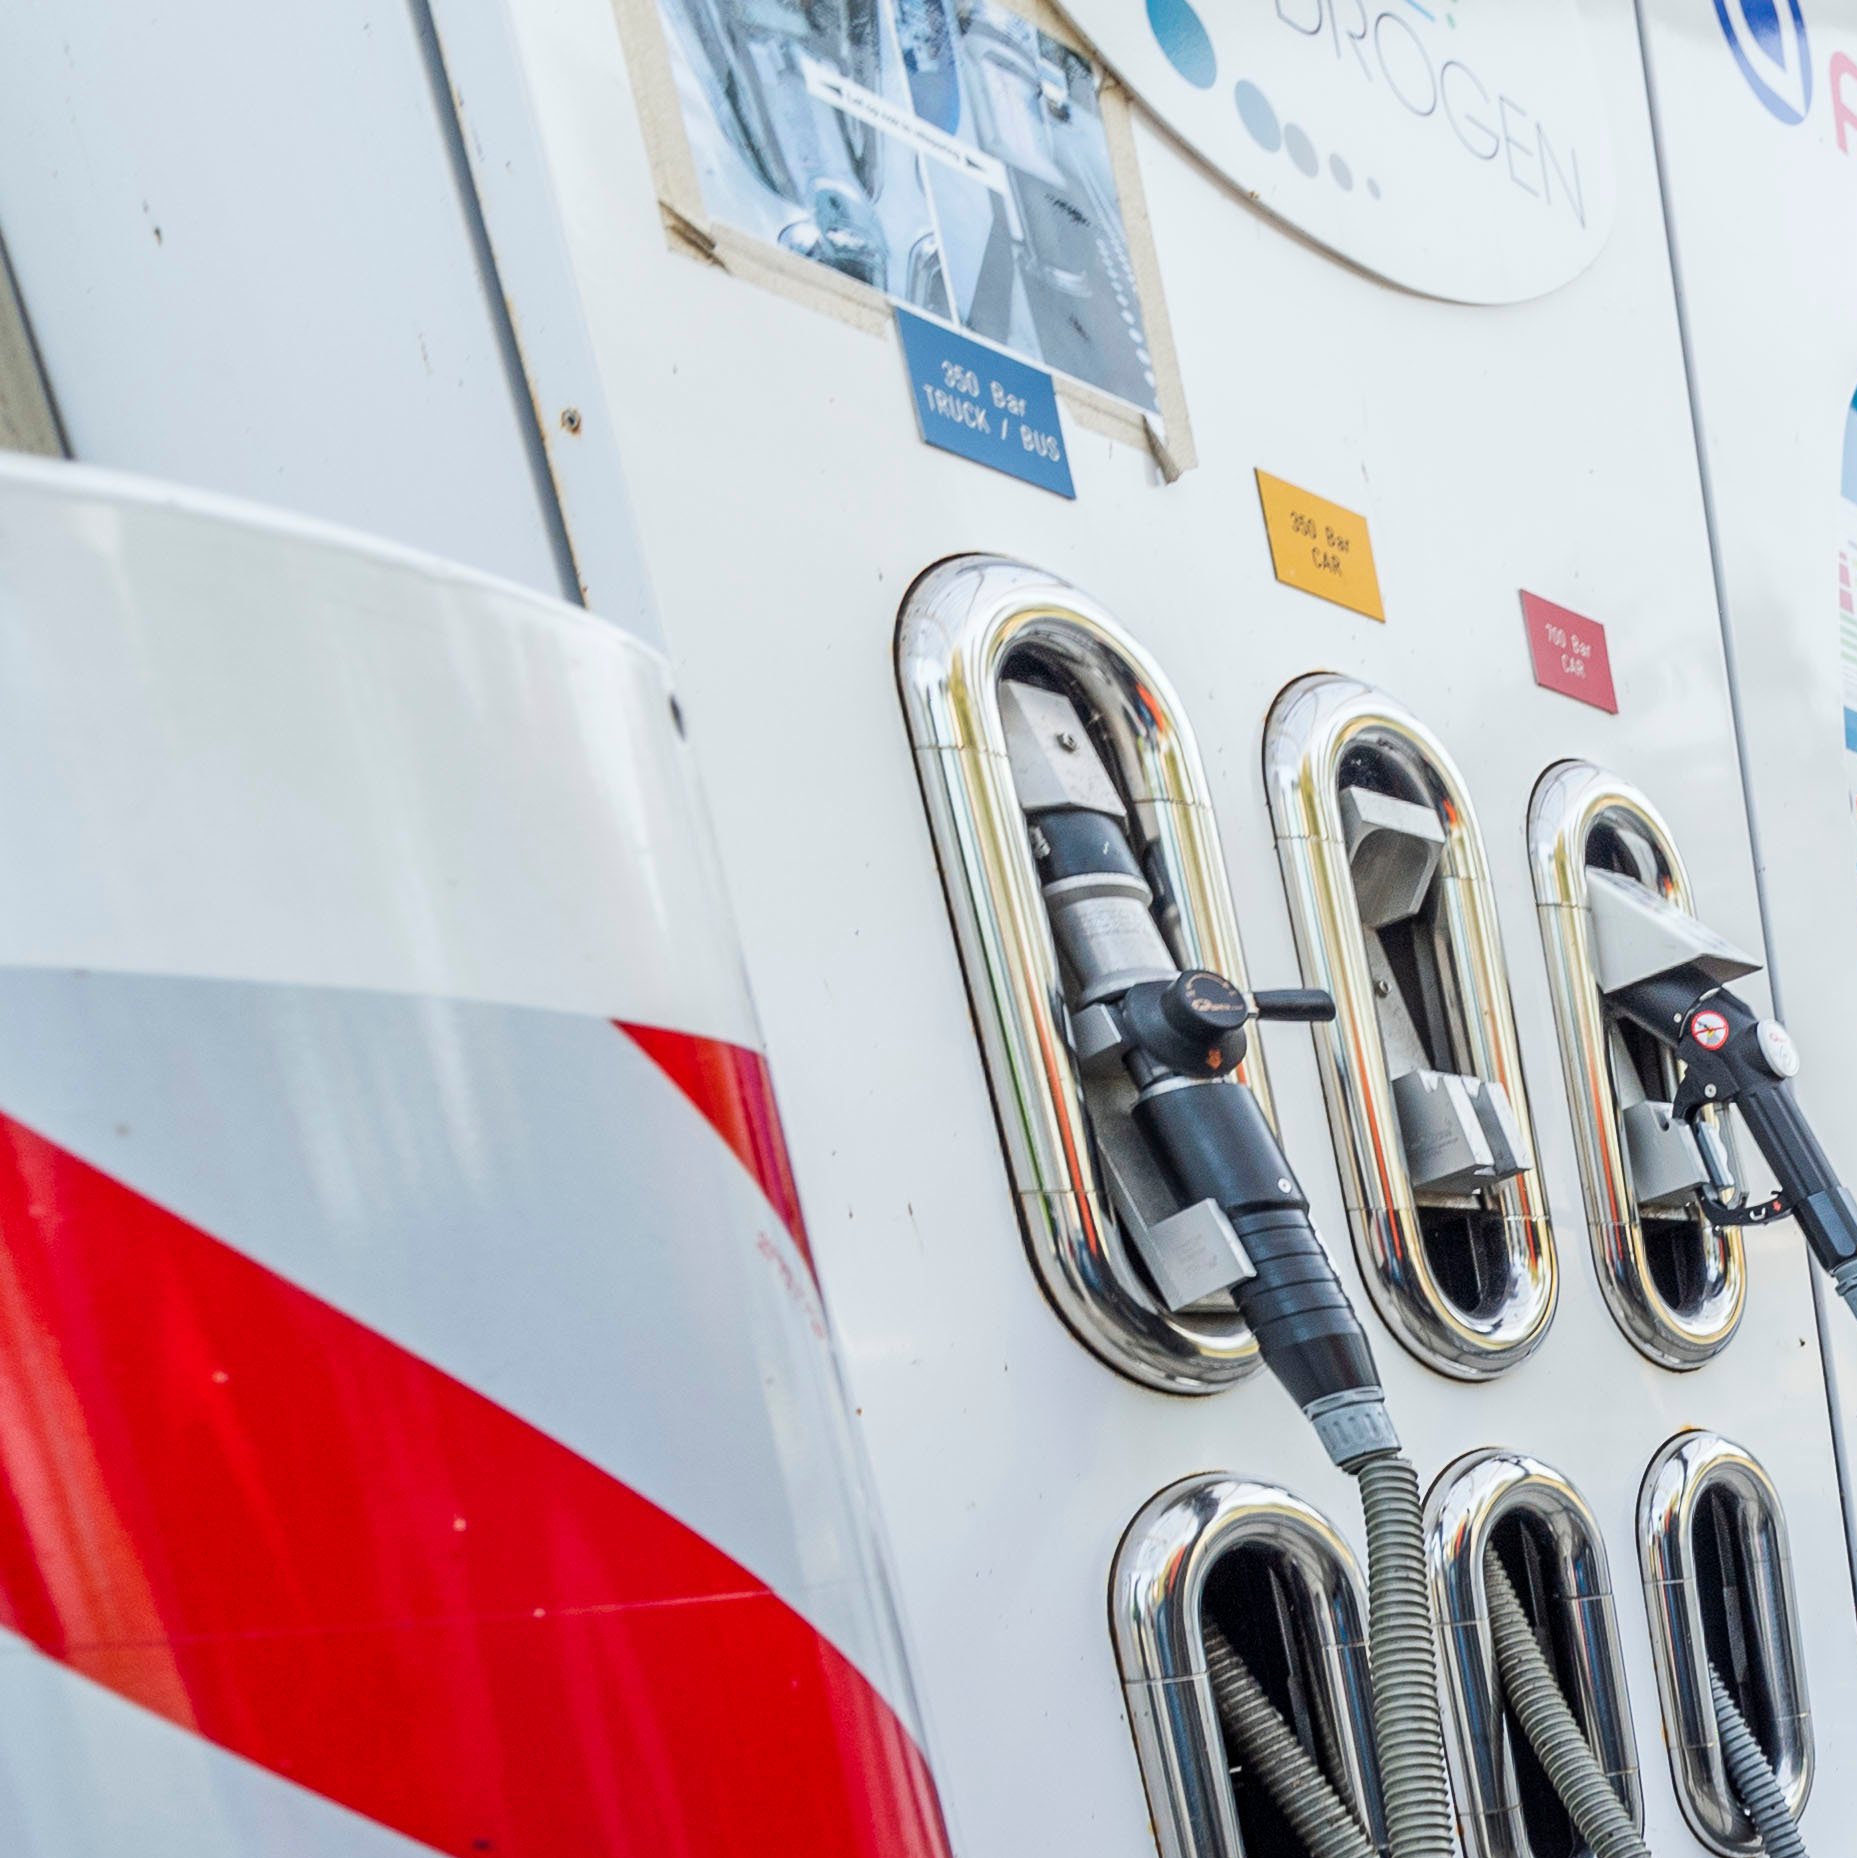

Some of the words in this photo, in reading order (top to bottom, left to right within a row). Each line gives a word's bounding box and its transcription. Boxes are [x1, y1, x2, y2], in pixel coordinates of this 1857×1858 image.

[941, 360, 980, 398] 350
[990, 380, 1027, 417] Bar
[923, 383, 991, 434] TRUCK
[1001, 418, 1009, 440] /
[1020, 424, 1061, 462] BUS
[1291, 510, 1318, 540] 350
[1324, 525, 1350, 553] Bar
[1311, 546, 1343, 577] CAR
[1545, 623, 1568, 648] 700
[1571, 634, 1591, 658] Bar
[1561, 653, 1586, 679] CAR
